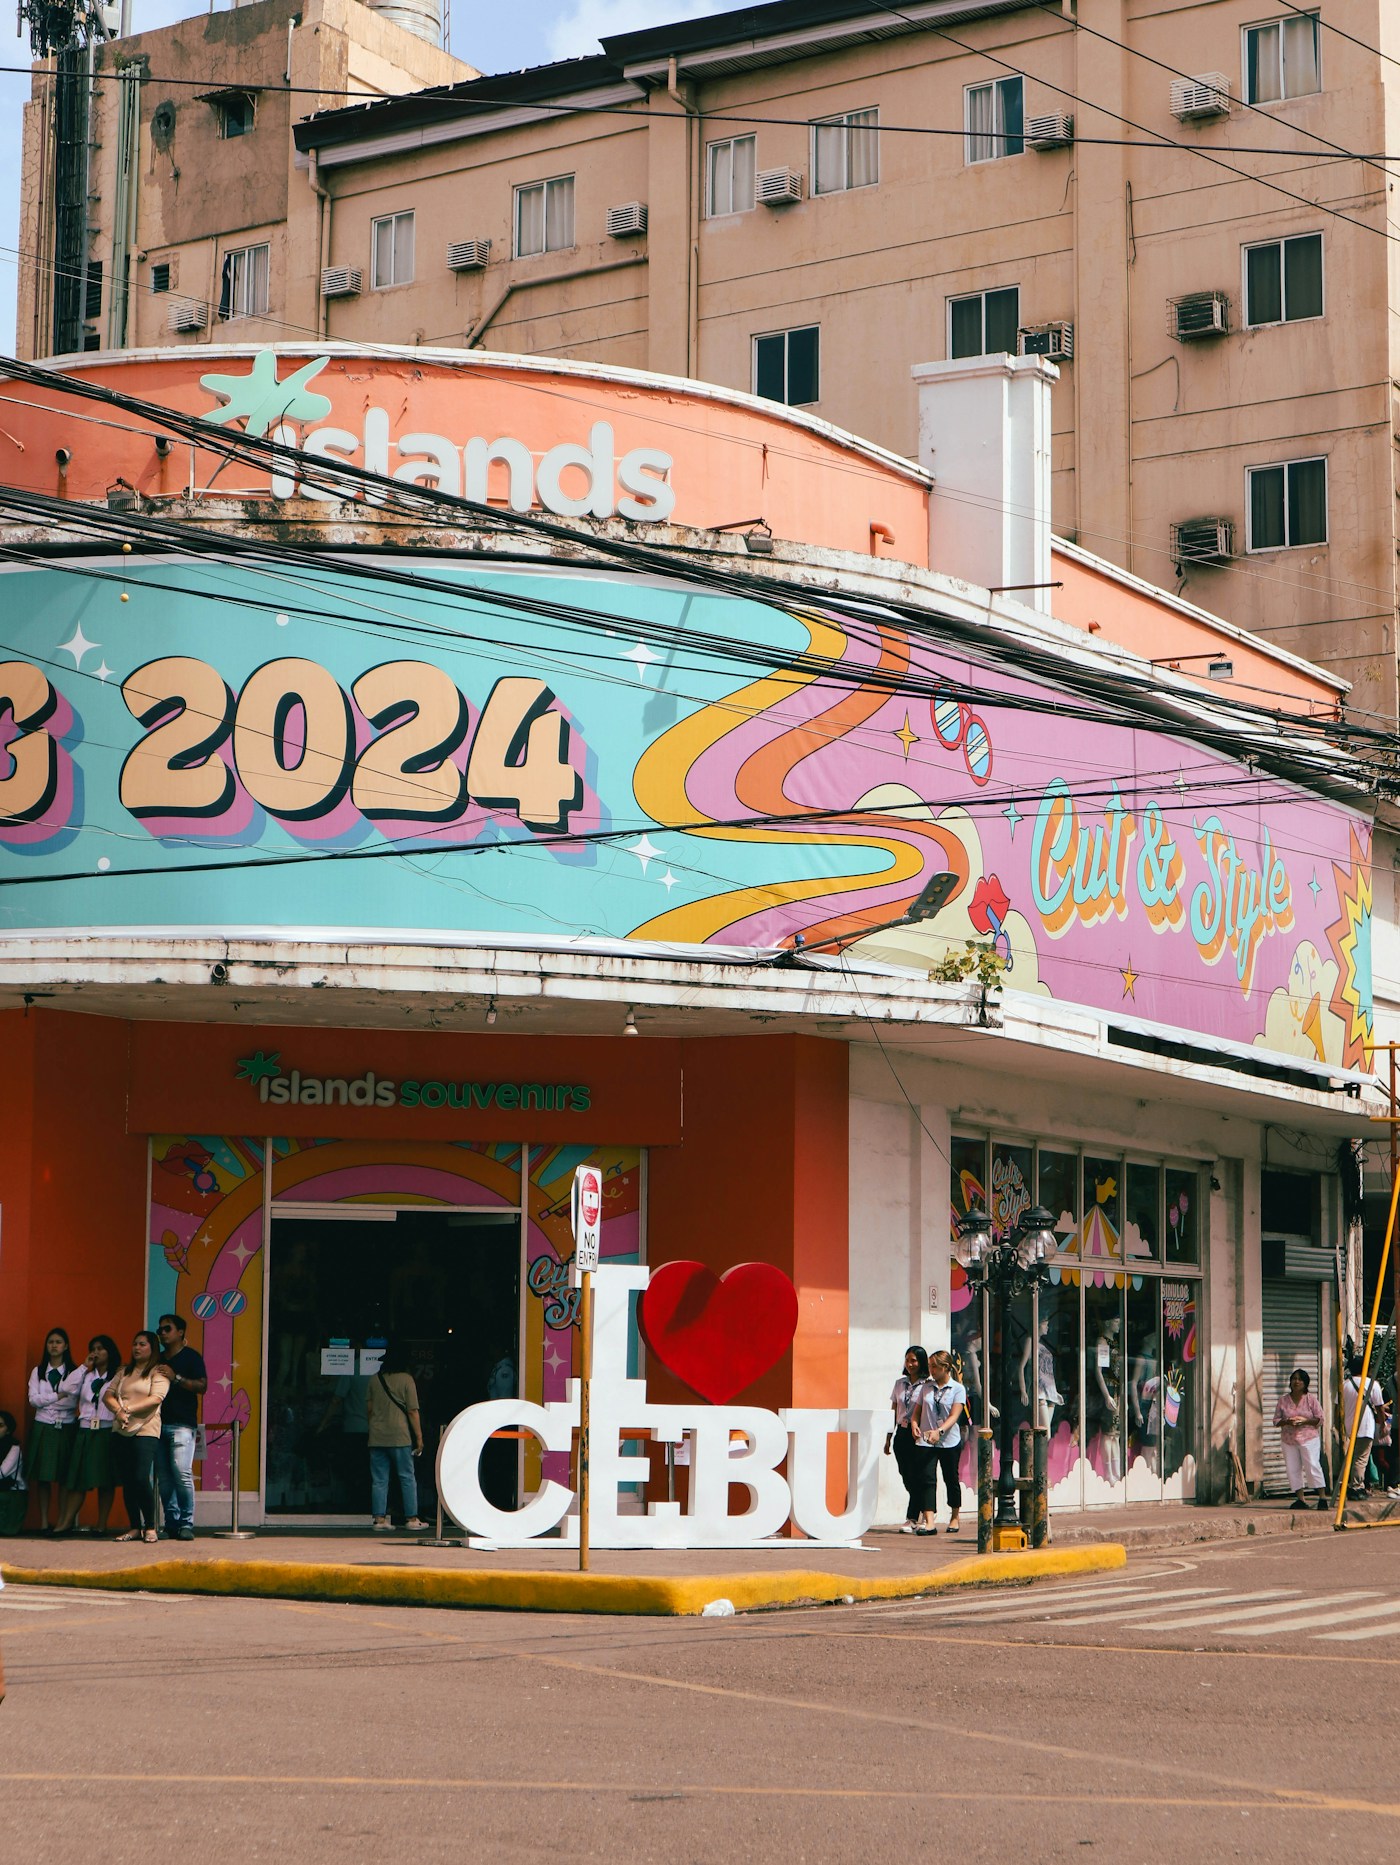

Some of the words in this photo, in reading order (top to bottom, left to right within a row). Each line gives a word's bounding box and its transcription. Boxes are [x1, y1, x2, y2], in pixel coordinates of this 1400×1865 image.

[270, 406, 677, 522] islands
[119, 656, 588, 838] 2024
[1030, 777, 1133, 930] Cut
[1137, 801, 1182, 922] &
[1190, 815, 1292, 992] Style
[260, 1070, 396, 1107] islands
[400, 1080, 591, 1112] souvenirs
[584, 1231, 596, 1249] NO
[999, 1182, 1031, 1229] Style
[528, 1252, 575, 1297] Cu
[1162, 1283, 1190, 1301] SINULOG
[563, 1264, 650, 1403] I
[435, 1399, 895, 1545] CEBU
